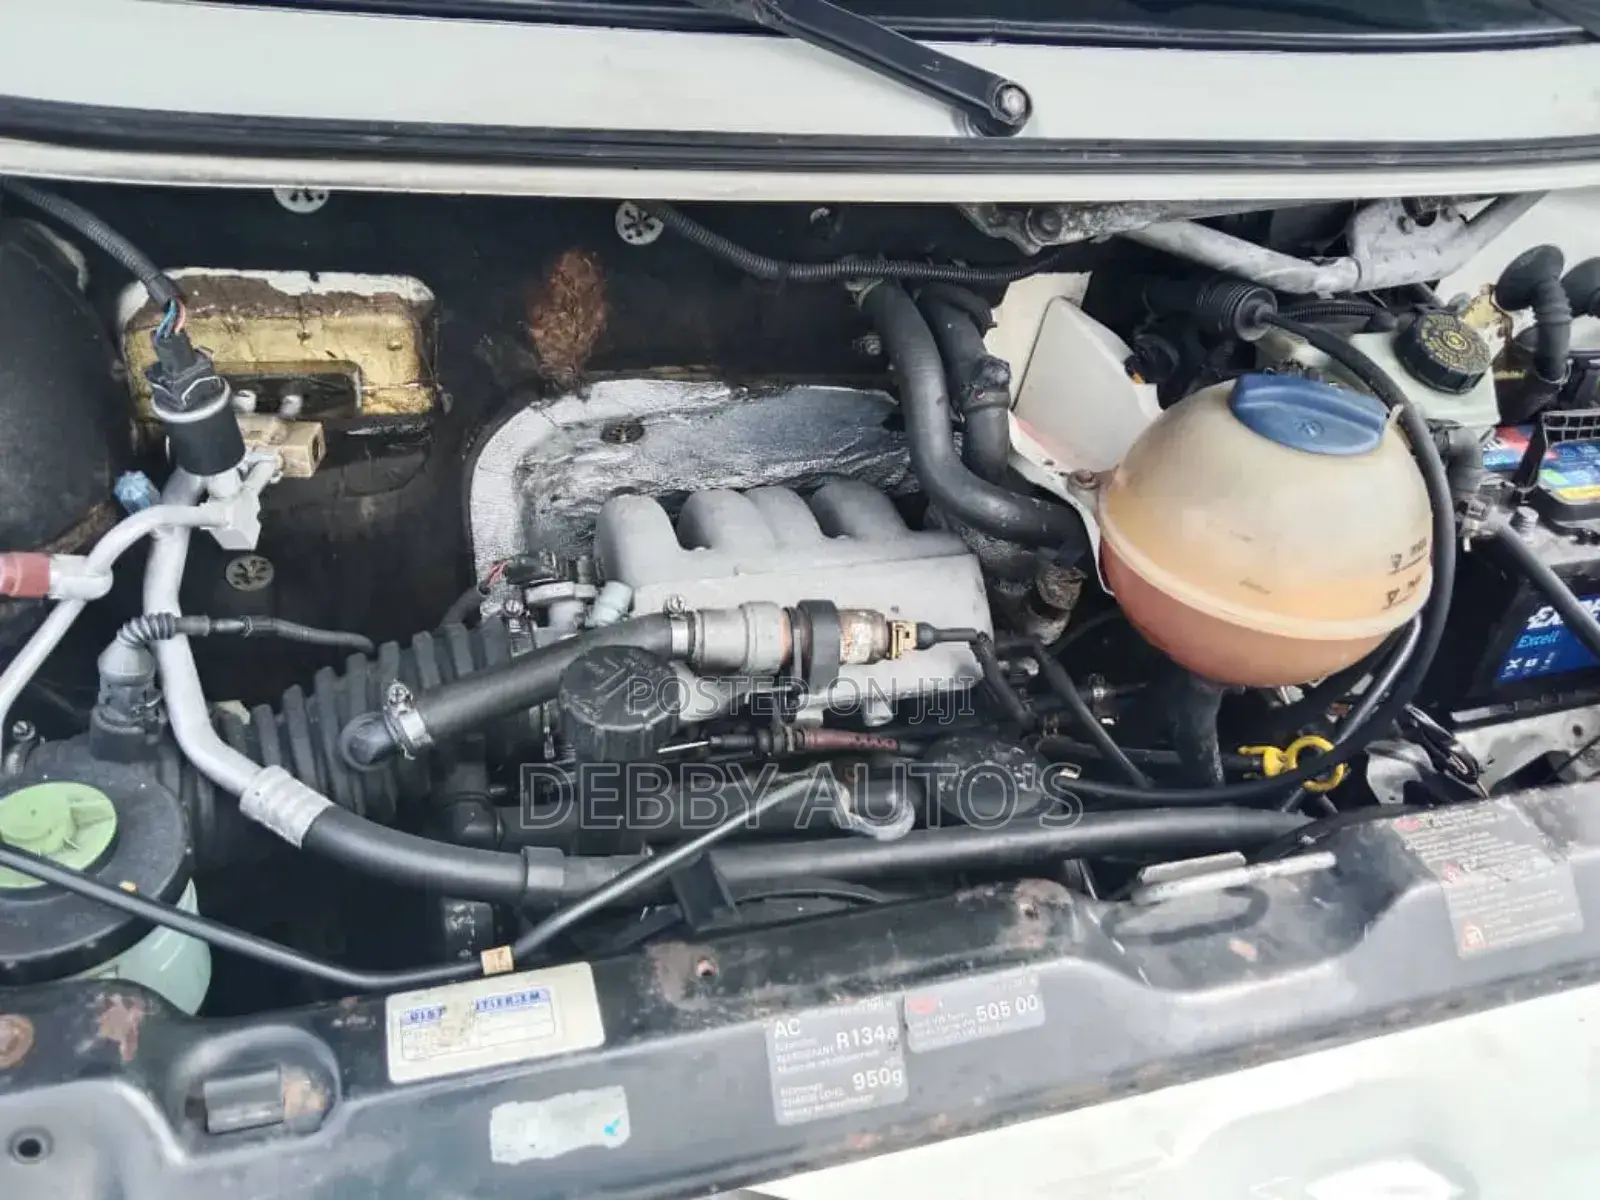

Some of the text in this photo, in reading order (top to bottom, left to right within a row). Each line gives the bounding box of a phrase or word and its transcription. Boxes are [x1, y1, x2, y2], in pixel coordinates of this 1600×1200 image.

[975, 994, 1039, 1023] 505 00
[774, 1018, 801, 1038] AC
[836, 1024, 898, 1049] R134a
[852, 1067, 903, 1091] 950g
